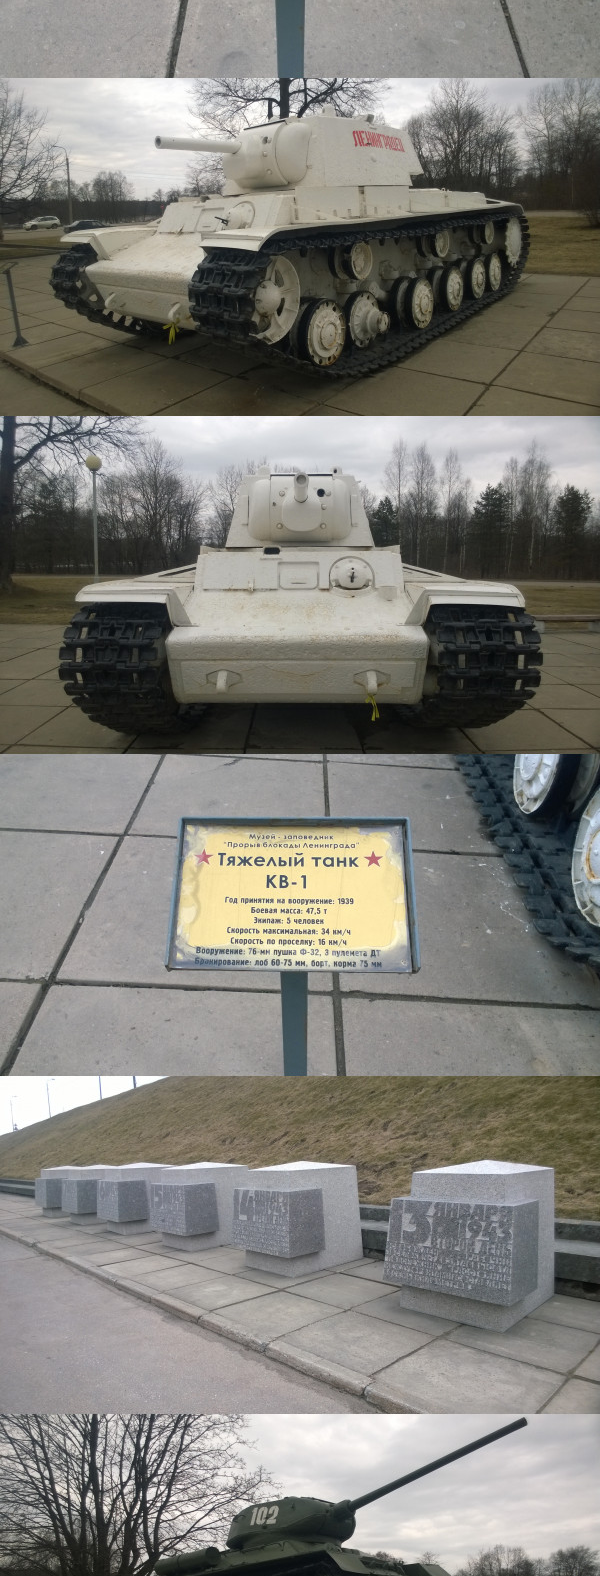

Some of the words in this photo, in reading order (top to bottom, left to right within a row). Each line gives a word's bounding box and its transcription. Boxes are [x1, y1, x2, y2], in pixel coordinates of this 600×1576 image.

[352, 130, 405, 152] ЛЕНИНГРАДЕЦ
[218, 853, 304, 867] Тяжелый
[311, 857, 359, 867] танк
[266, 875, 306, 889] КВ-1
[227, 927, 260, 935] Скорость
[459, 1220, 513, 1244] 1943
[250, 1505, 279, 1526] 102
